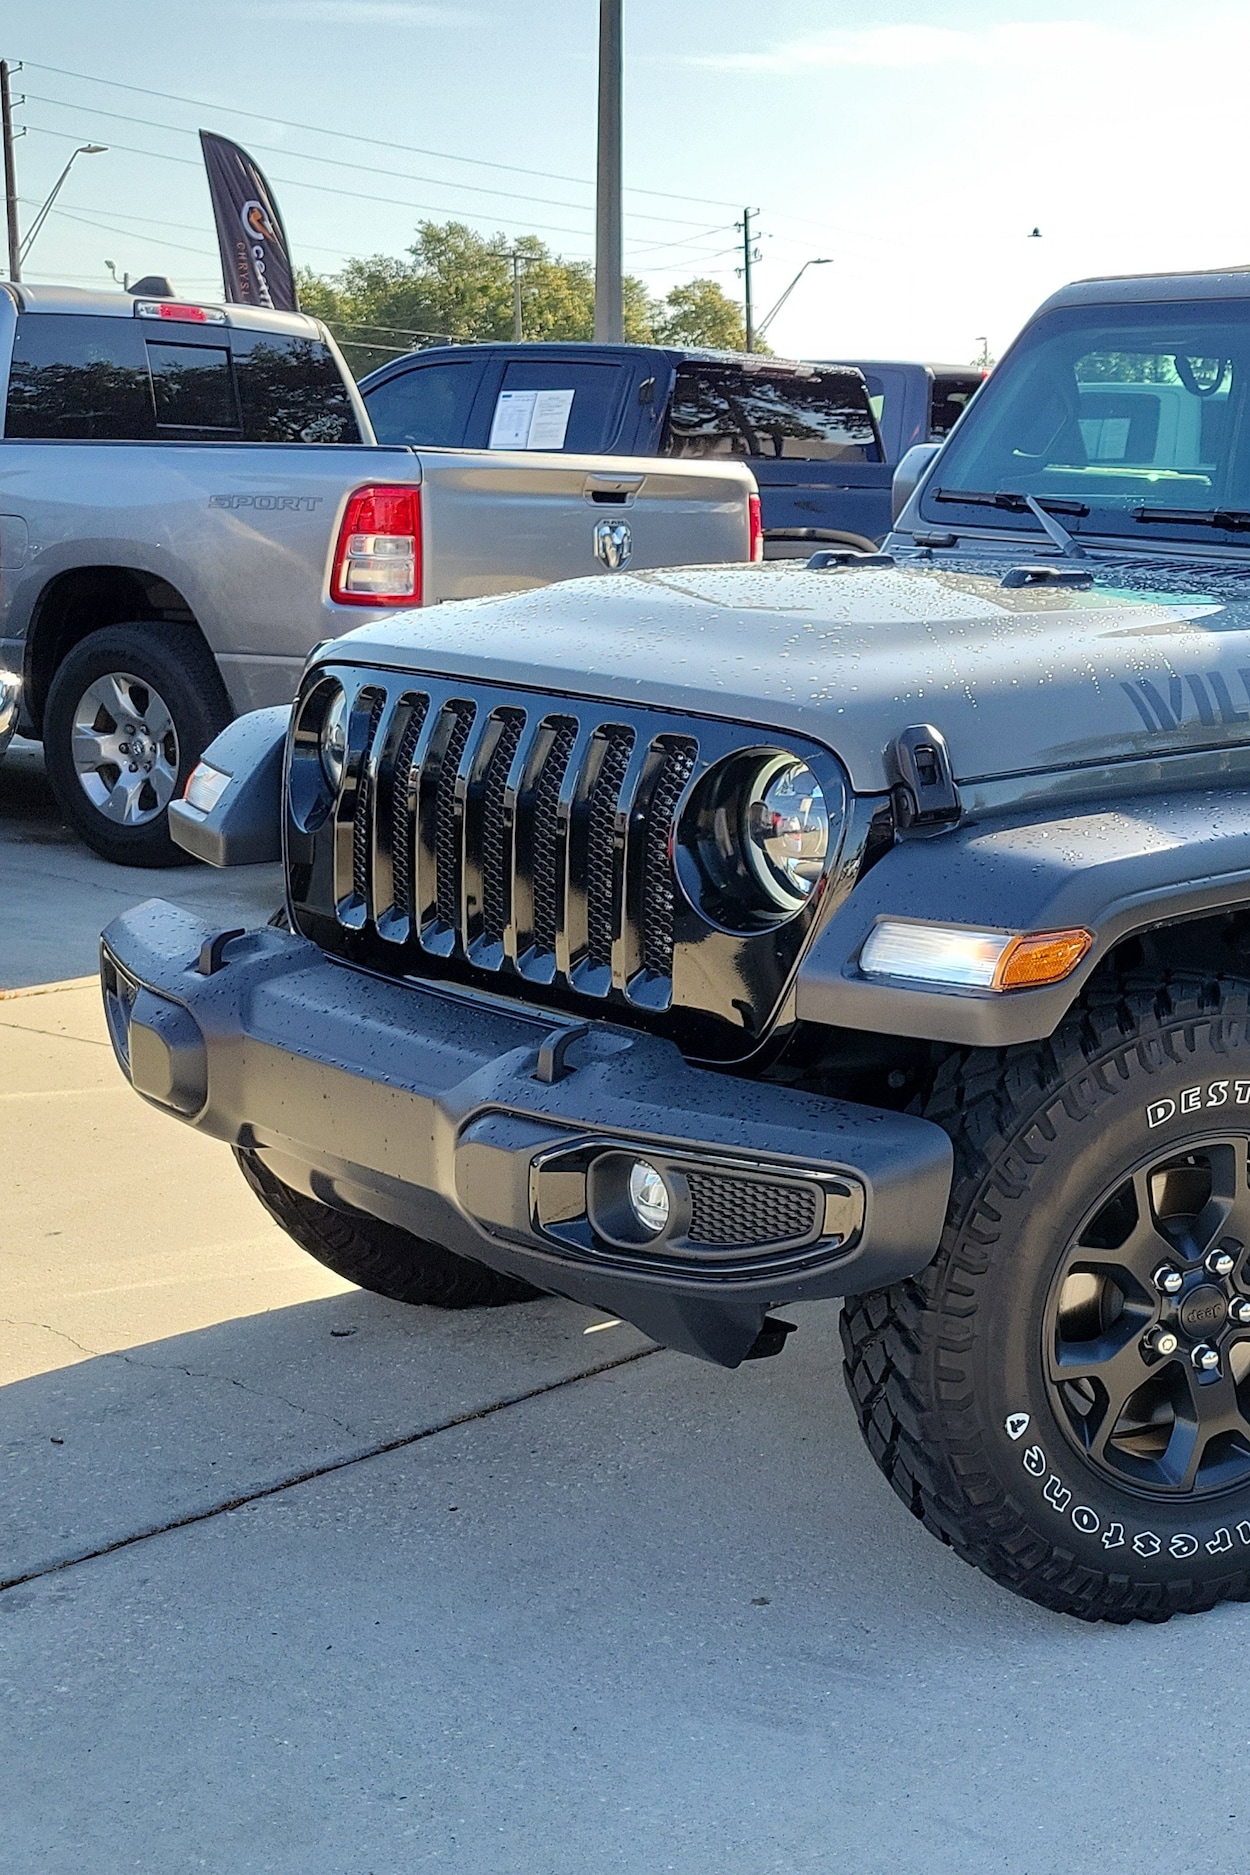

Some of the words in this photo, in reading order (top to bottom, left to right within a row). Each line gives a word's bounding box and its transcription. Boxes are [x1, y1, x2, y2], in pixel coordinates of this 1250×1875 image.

[236, 241, 250, 304] CHRYSL
[208, 494, 323, 511] SPORT
[1187, 1303, 1222, 1323] Jeep
